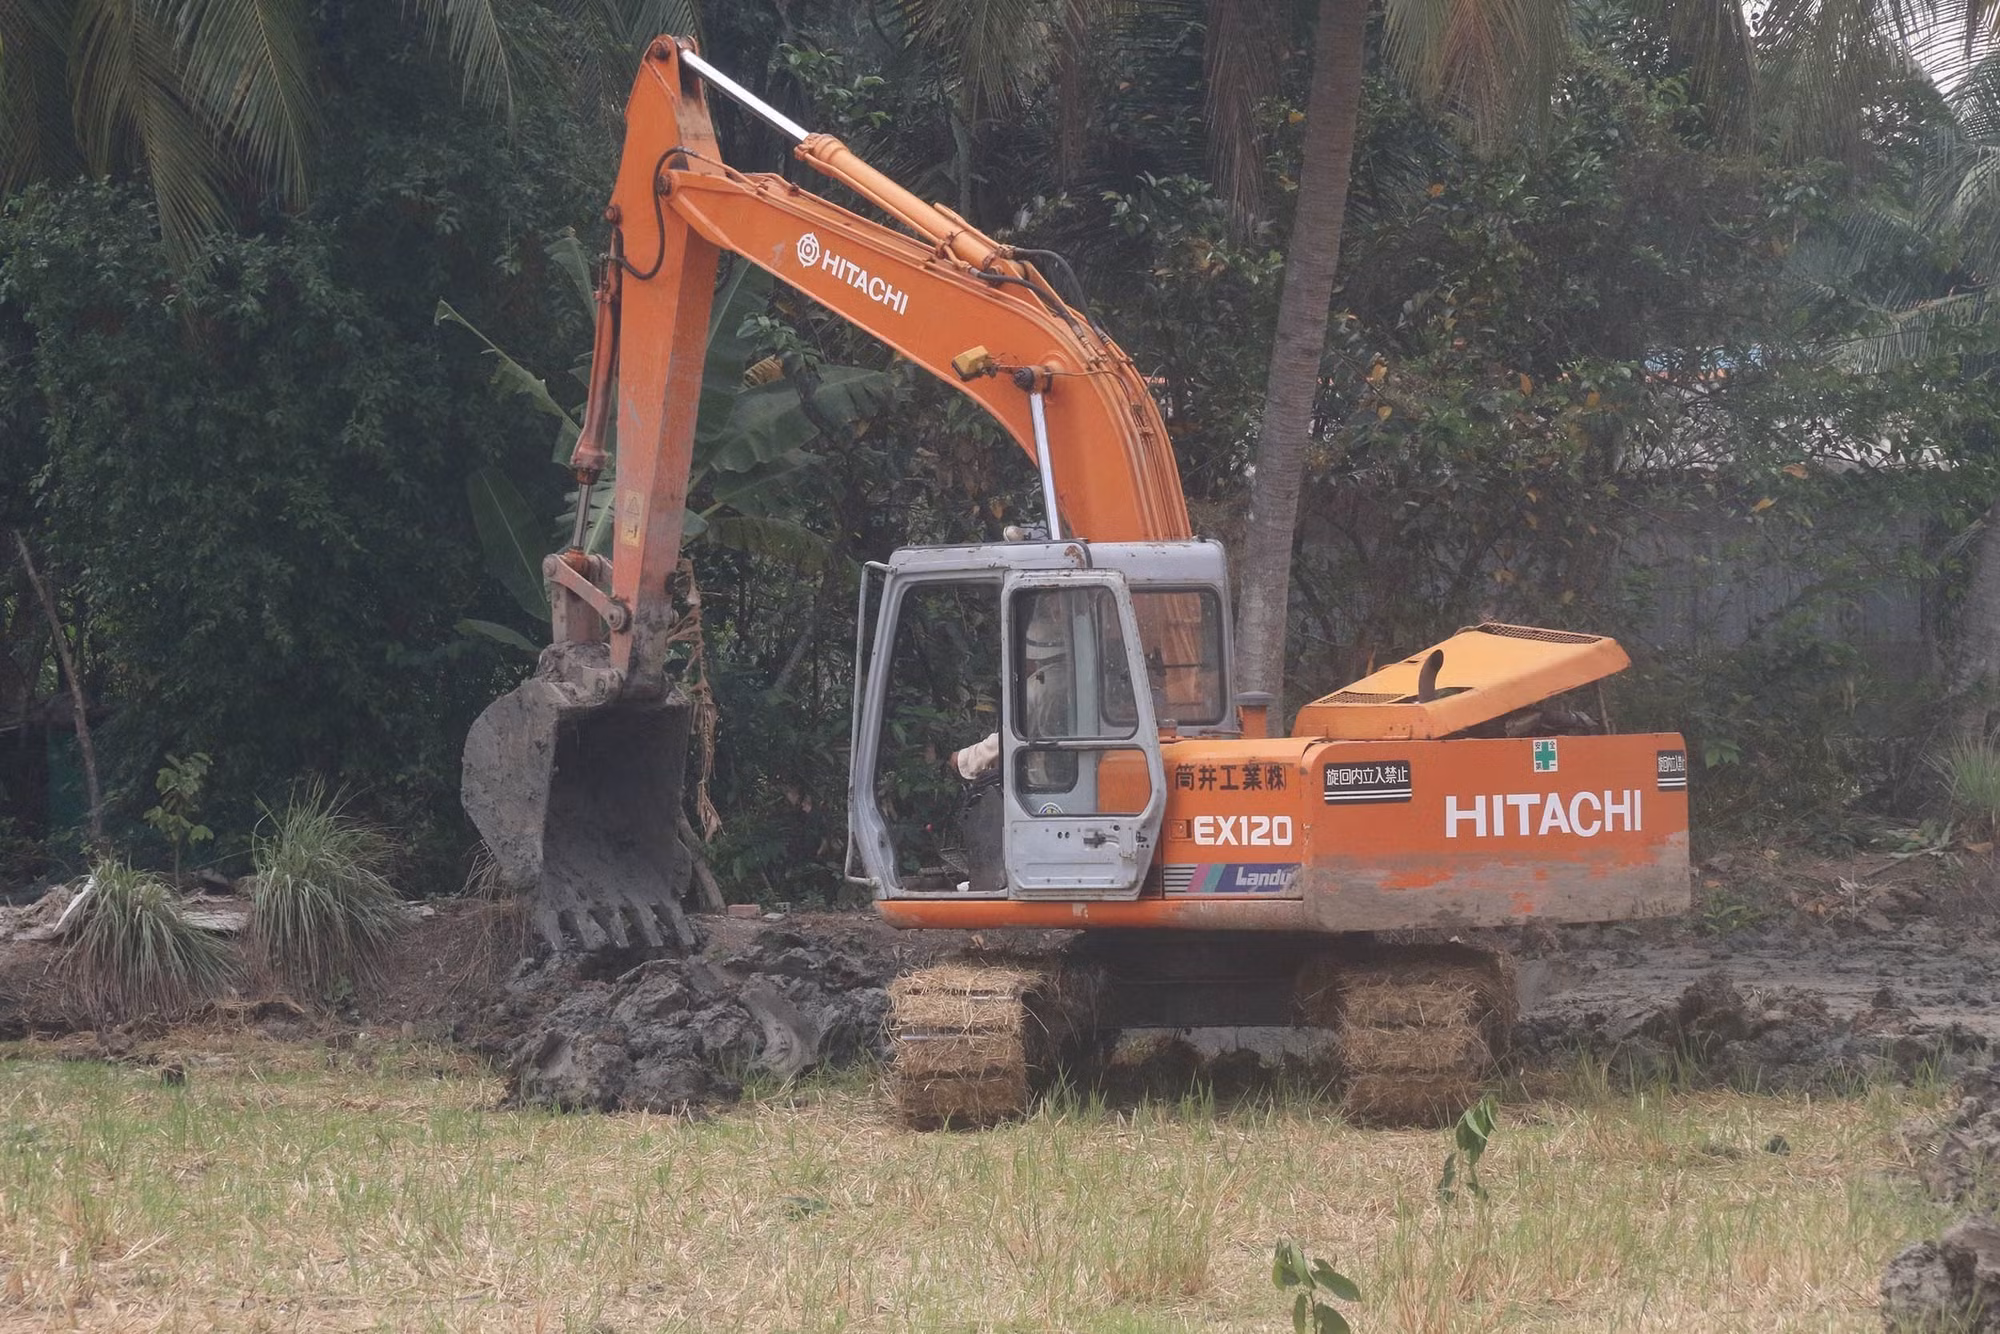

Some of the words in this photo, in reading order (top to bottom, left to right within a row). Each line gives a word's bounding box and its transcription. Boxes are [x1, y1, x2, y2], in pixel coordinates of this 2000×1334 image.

[821, 249, 909, 316] HITACHI
[1326, 766, 1409, 786] 旋回内立入禁止
[1193, 815, 1293, 846] EX120
[1445, 789, 1642, 838] HITACHI
